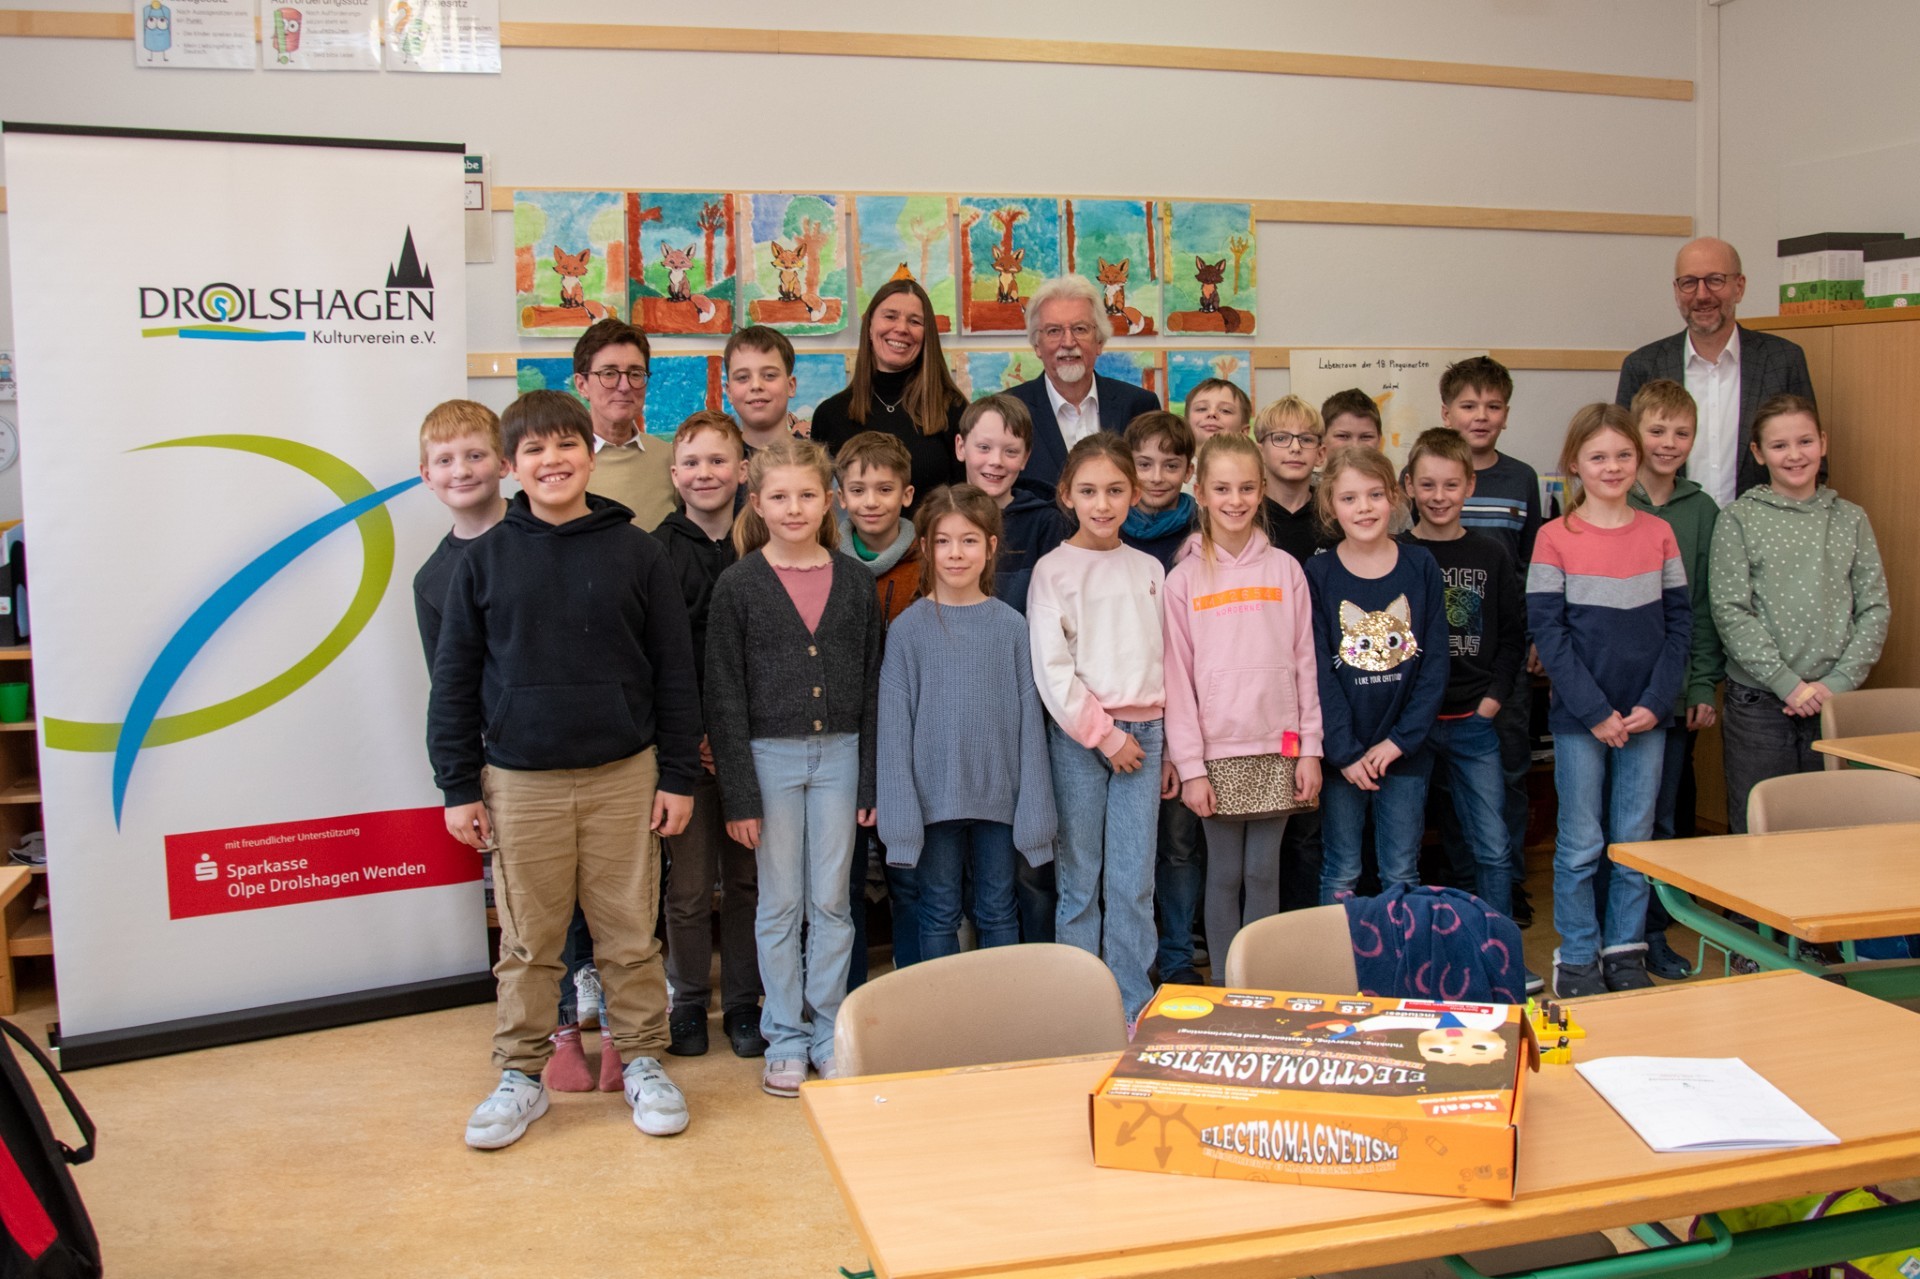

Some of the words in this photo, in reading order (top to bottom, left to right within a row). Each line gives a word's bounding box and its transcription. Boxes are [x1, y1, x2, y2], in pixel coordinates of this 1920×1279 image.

[464, 160, 480, 170] be
[138, 282, 435, 323] DROLSHAGEN
[313, 329, 405, 344] Kulturverein
[410, 330, 437, 345] e.V.
[1376, 359, 1386, 368] 18
[1358, 676, 1369, 686] LIKE
[1369, 675, 1382, 684] YOUR
[225, 840, 241, 849] mit
[242, 834, 296, 848] freundlicher
[297, 826, 360, 842] Unterstützung
[226, 857, 308, 880] Sparkasse
[227, 880, 266, 899] Olpe
[270, 870, 360, 892] Drolshagen
[363, 862, 426, 880] Wenden
[1230, 999, 1266, 1008] 26+
[1292, 1003, 1316, 1011] 40
[1341, 1005, 1367, 1014] 18
[1243, 1032, 1260, 1040] and
[1136, 1050, 1426, 1085] ELECTROMAGNETISM
[1200, 1119, 1399, 1164] ELECTROMAGNETISM
